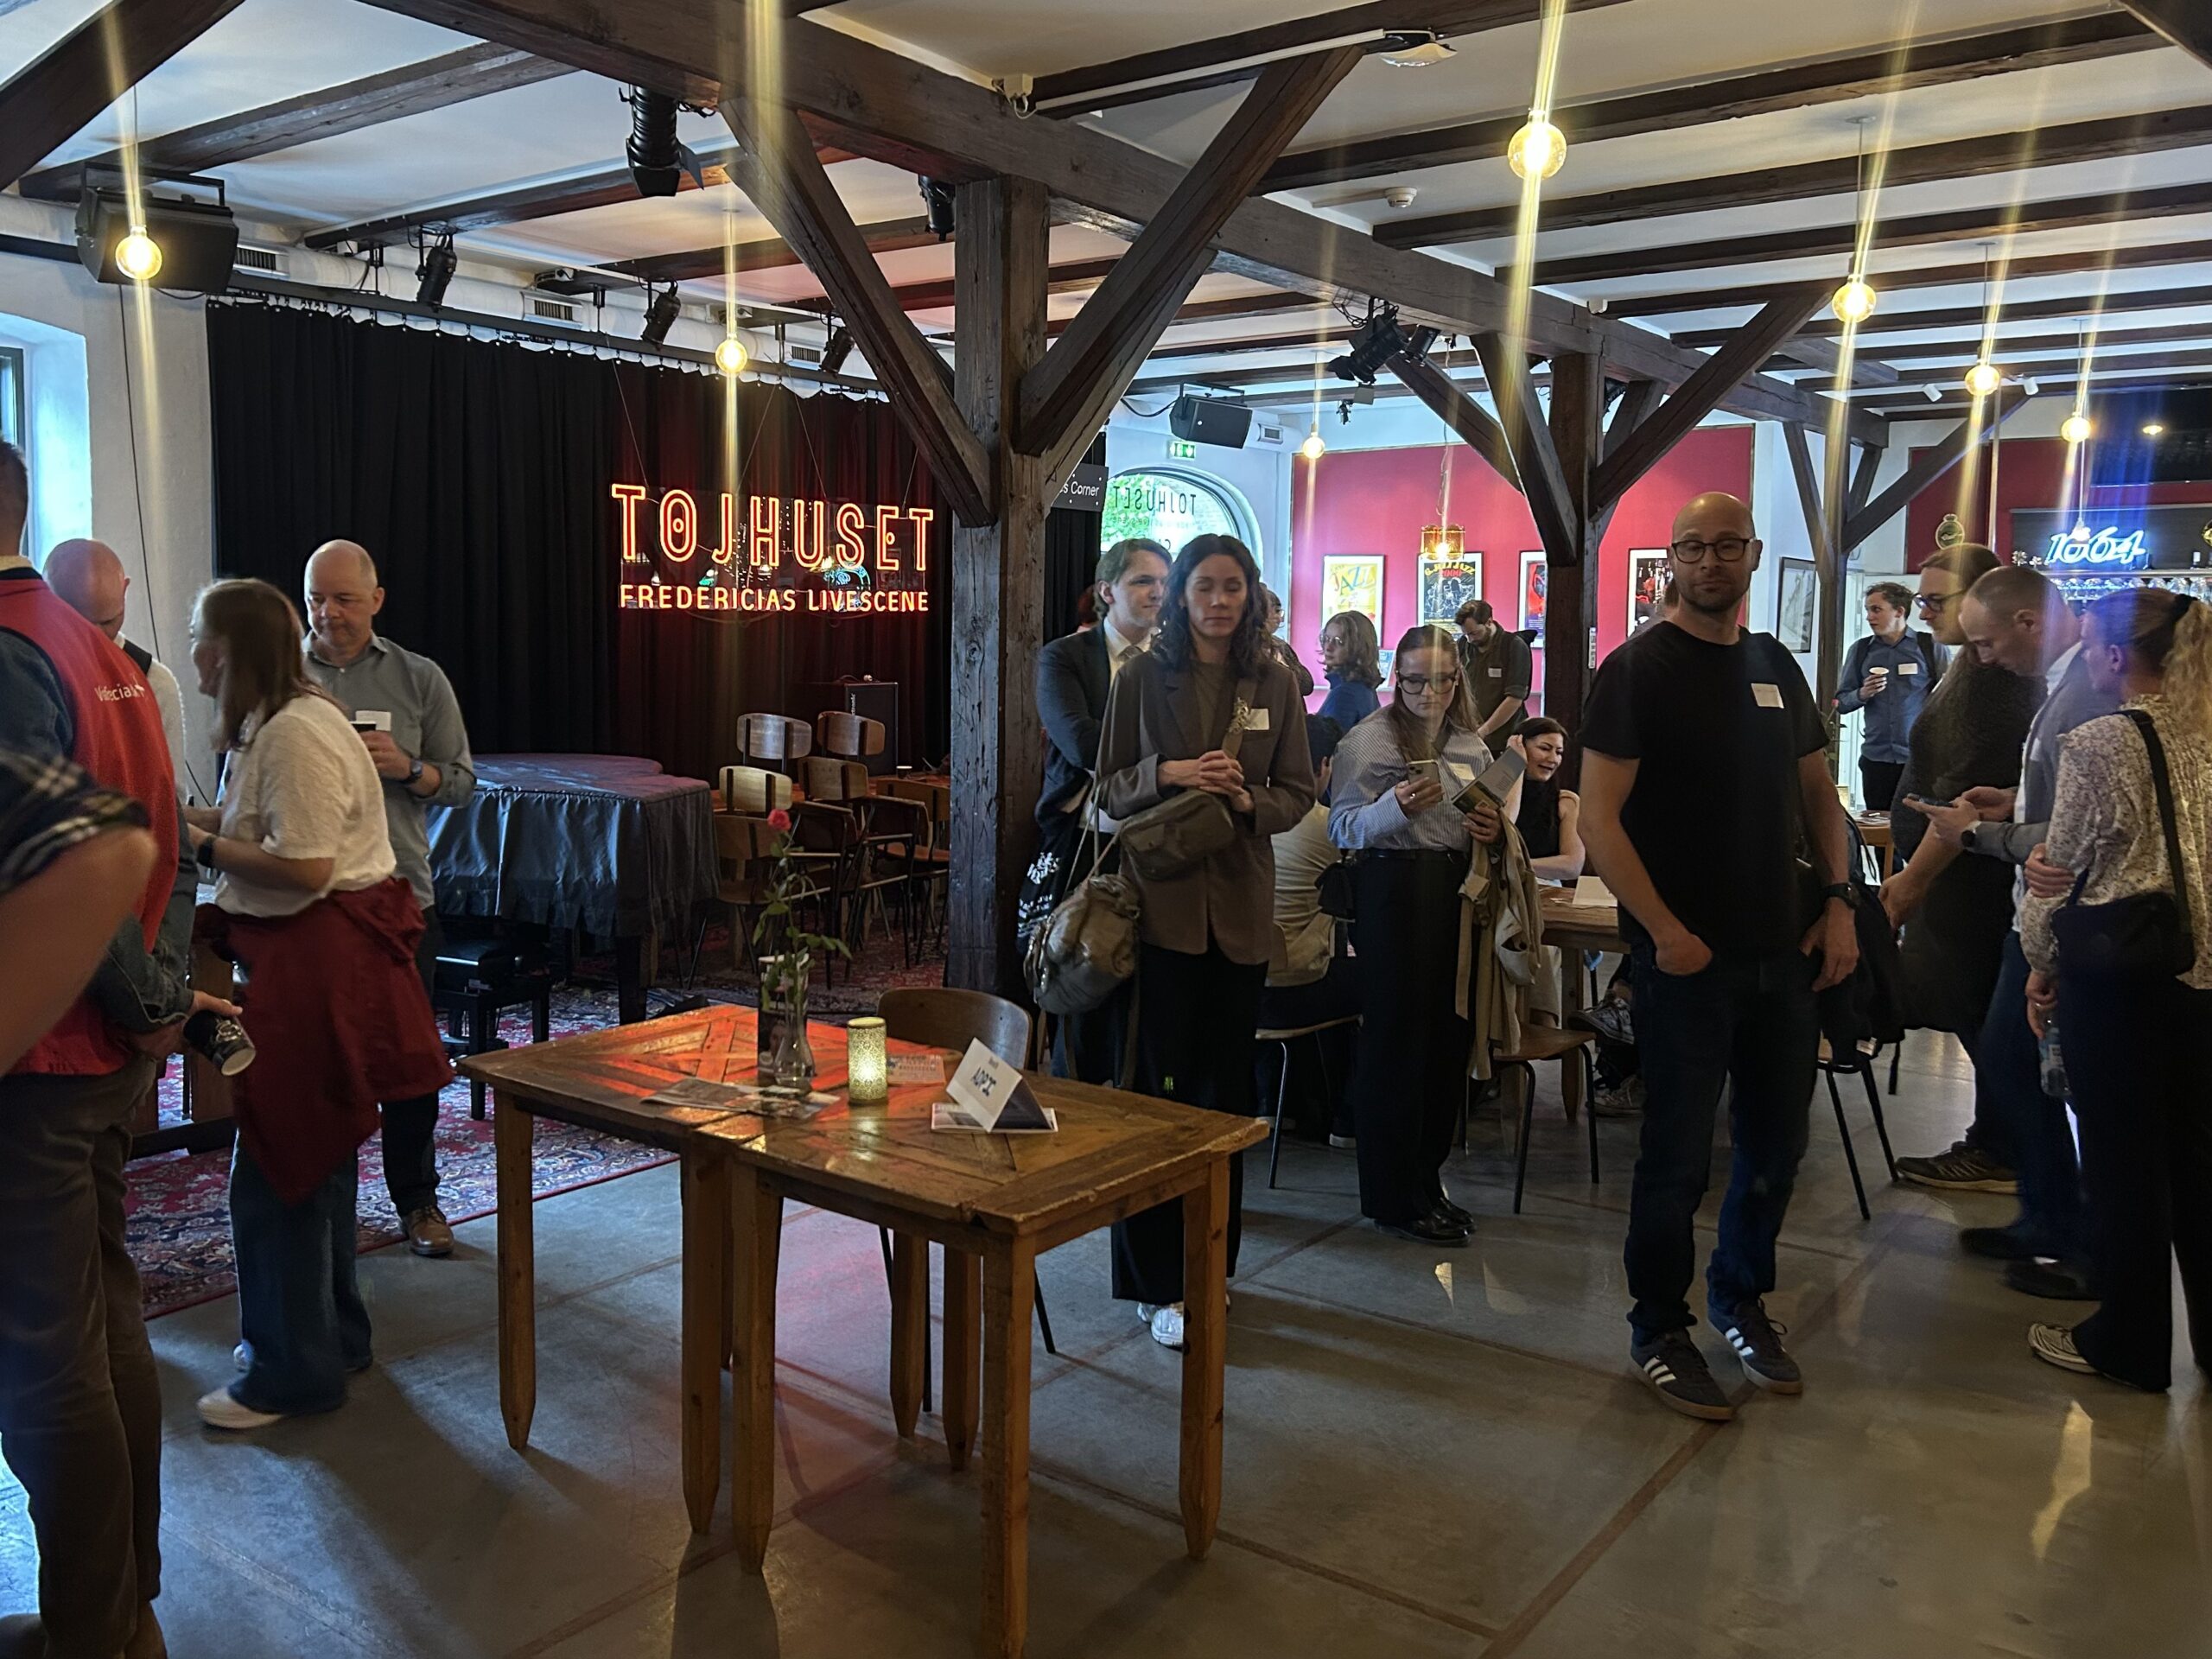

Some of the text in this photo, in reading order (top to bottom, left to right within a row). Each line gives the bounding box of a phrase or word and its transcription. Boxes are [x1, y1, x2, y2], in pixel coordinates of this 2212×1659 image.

[1071, 480, 1100, 497] Corner
[620, 584, 929, 613] FREDERICIAS LIVESCENE
